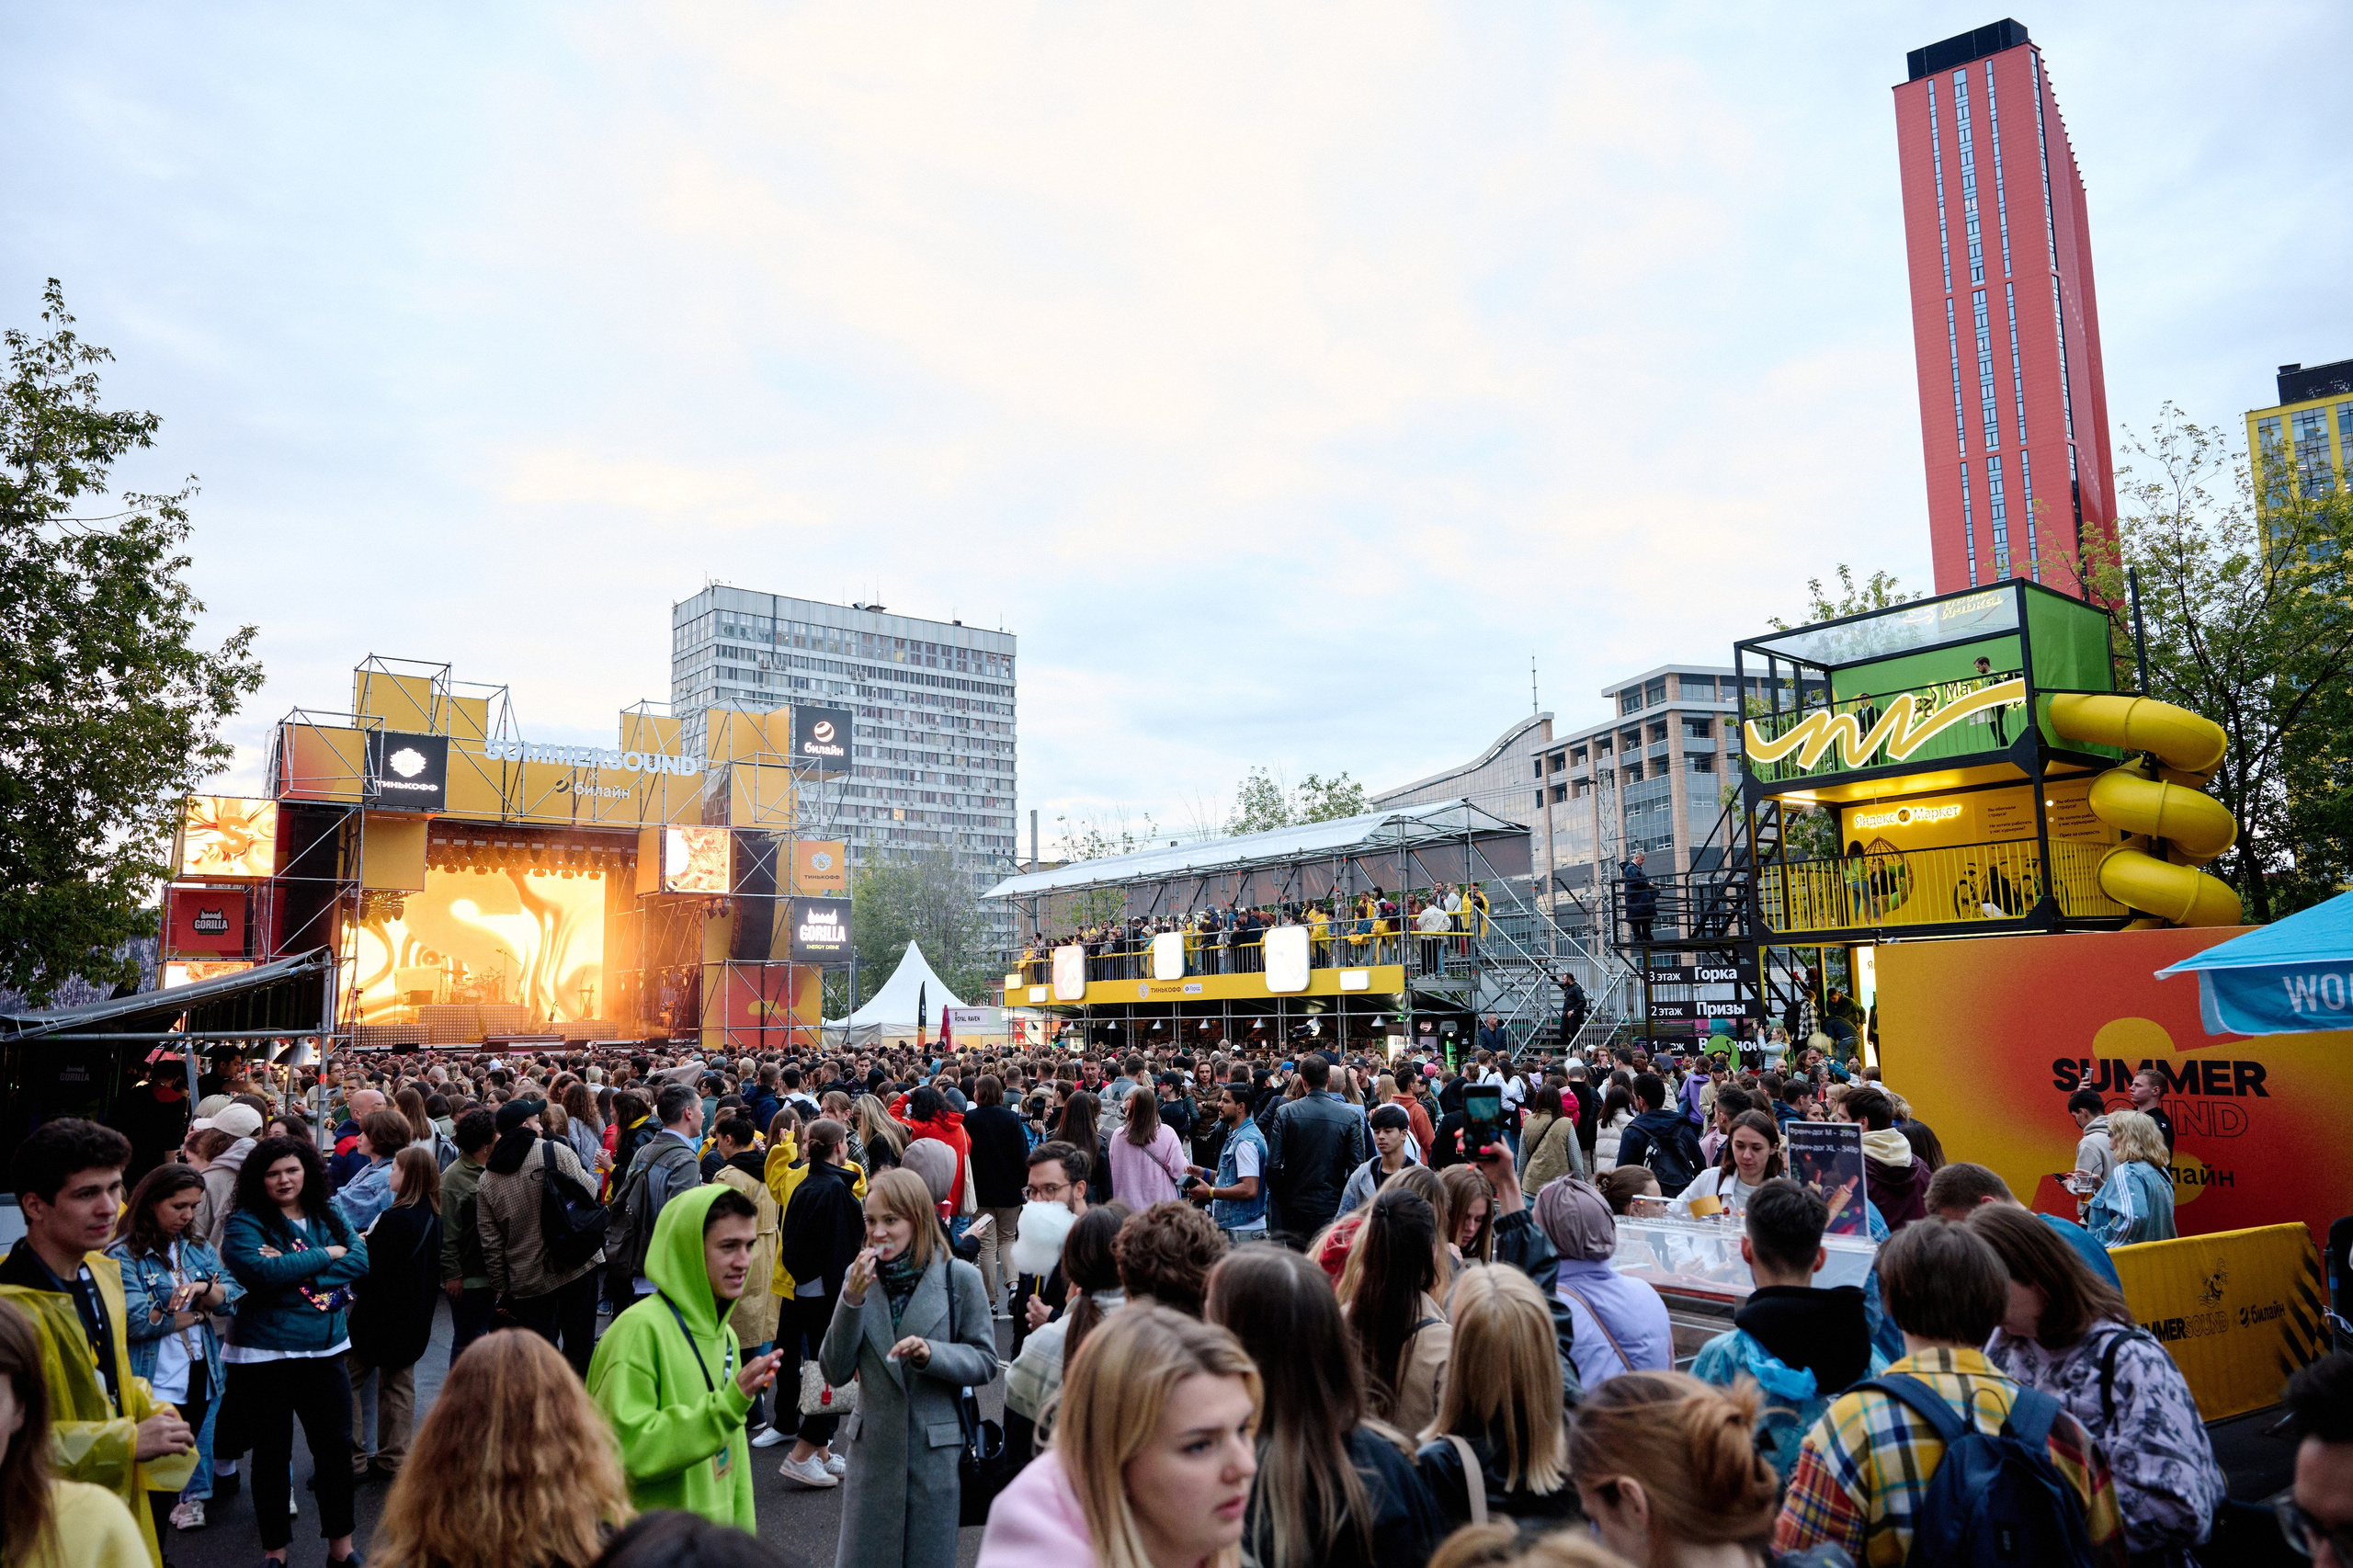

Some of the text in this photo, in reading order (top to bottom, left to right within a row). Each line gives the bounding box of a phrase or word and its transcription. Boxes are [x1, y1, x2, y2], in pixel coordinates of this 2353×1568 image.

[484, 738, 699, 776] SUMMERSOUND
[804, 742, 844, 756] билайн
[574, 781, 631, 799] билайн
[1855, 805, 1959, 827] Яндекс Маркет
[194, 919, 228, 929] GORILLA
[799, 924, 846, 942] GORILLA
[1867, 960, 1875, 970] Я
[1649, 966, 1737, 983] 3 этаж Горка
[2281, 972, 2353, 1013] WO
[1651, 1001, 1746, 1018] 2 этаж Призы
[1653, 1040, 1658, 1051] 1
[60, 1073, 90, 1082] GORILLA
[2052, 1058, 2270, 1097] SUMMER
[1789, 1127, 1824, 1136] Френч-дог
[1790, 1142, 1825, 1152] Френч-дог
[2170, 1163, 2234, 1187] лайн
[2251, 1300, 2286, 1324] билайн
